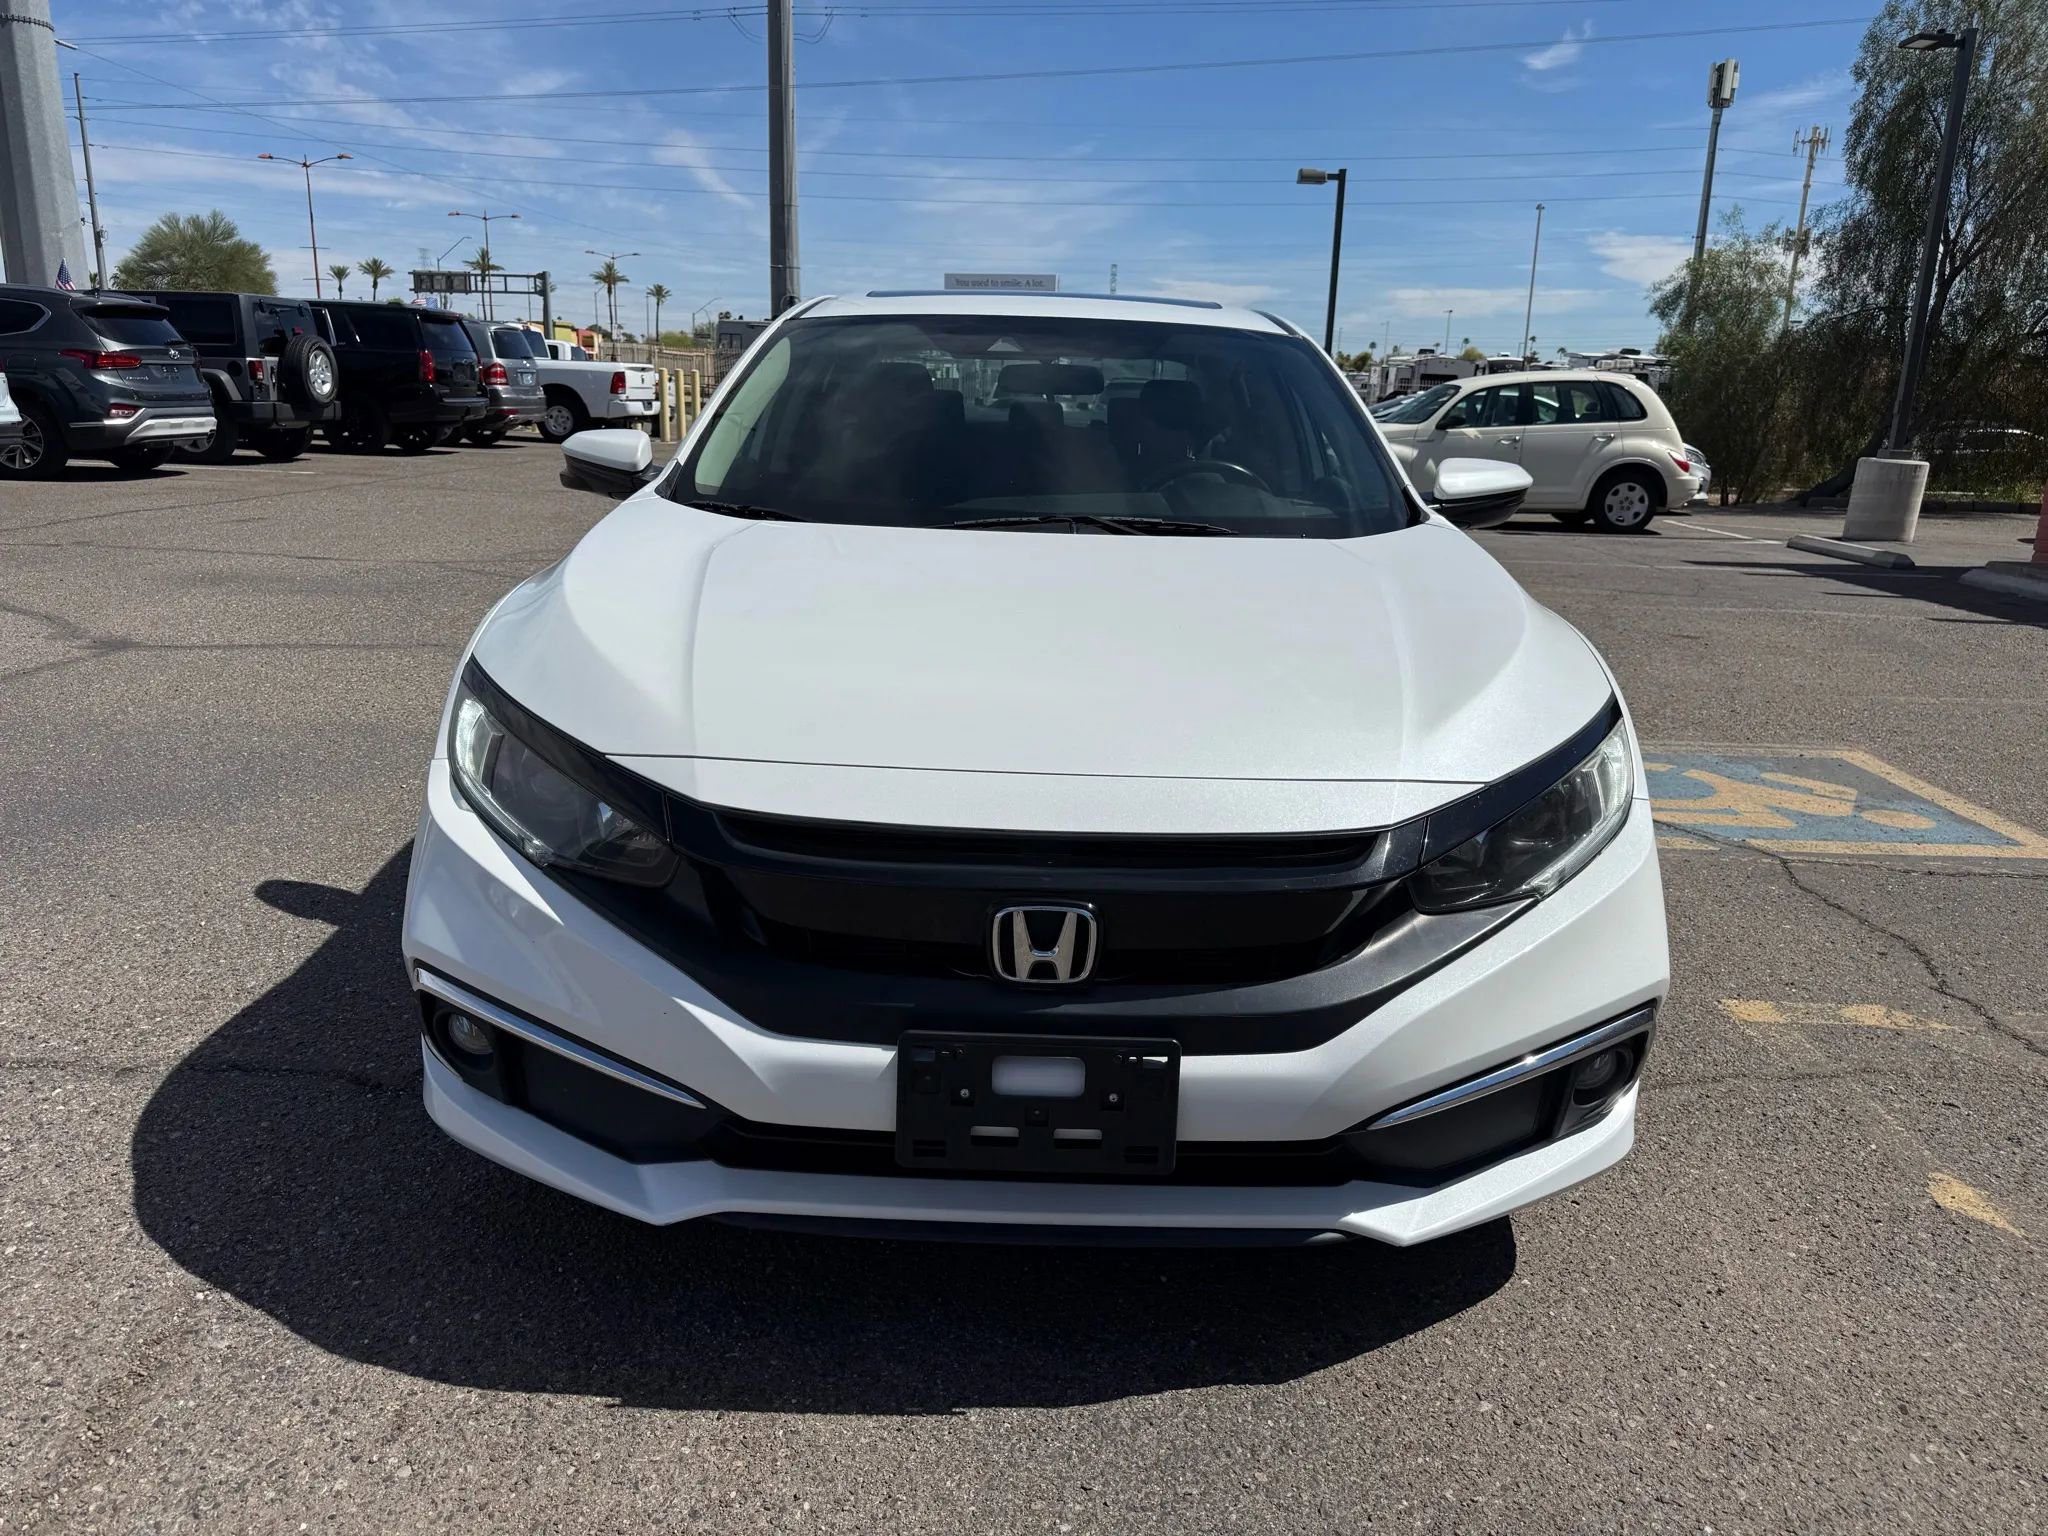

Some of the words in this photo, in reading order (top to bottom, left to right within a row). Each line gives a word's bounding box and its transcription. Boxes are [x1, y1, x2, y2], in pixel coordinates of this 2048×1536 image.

[953, 278, 969, 287] You
[971, 278, 989, 287] used
[991, 278, 999, 287] to
[1024, 279, 1031, 288] A
